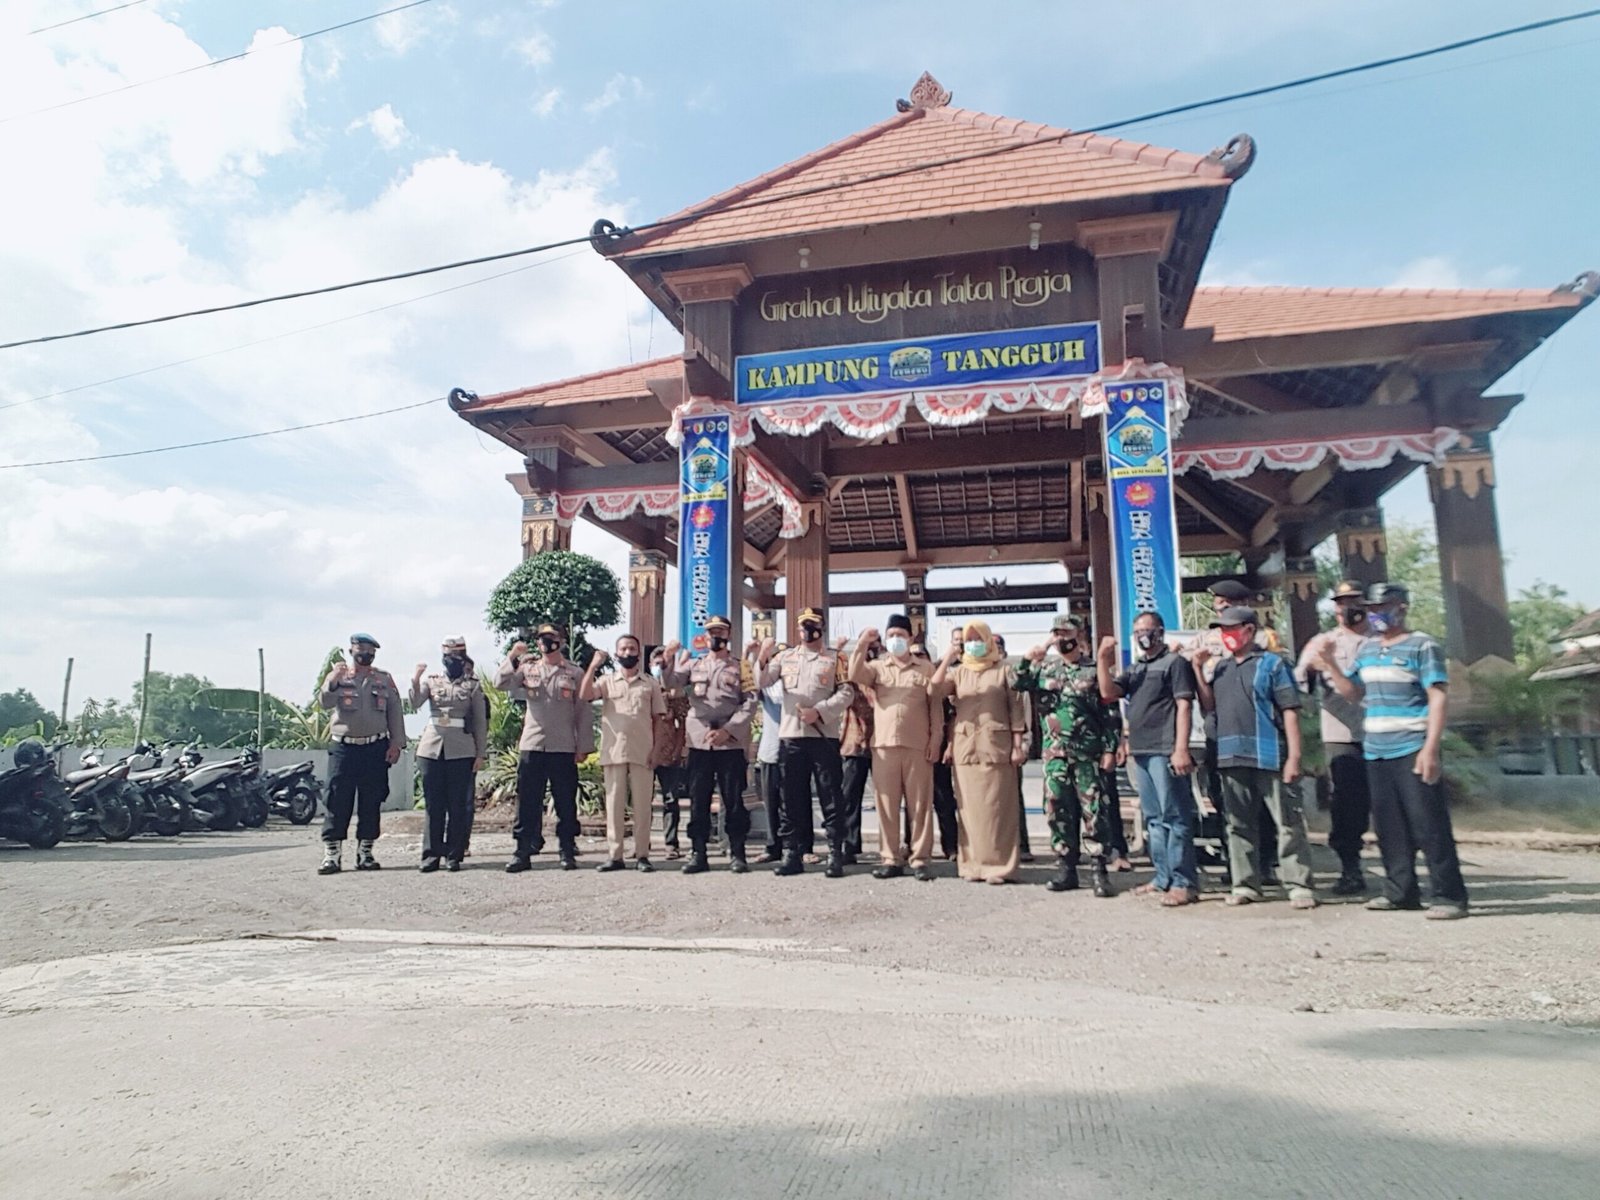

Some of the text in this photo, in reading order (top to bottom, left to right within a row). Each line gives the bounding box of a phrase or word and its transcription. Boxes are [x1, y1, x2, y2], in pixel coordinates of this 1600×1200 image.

[760, 287, 842, 322] Graha
[845, 280, 932, 324] Wiyata
[934, 271, 994, 306] Tata
[998, 266, 1072, 307] Praja
[747, 339, 1086, 390] KAMPUNG TANGGUH
